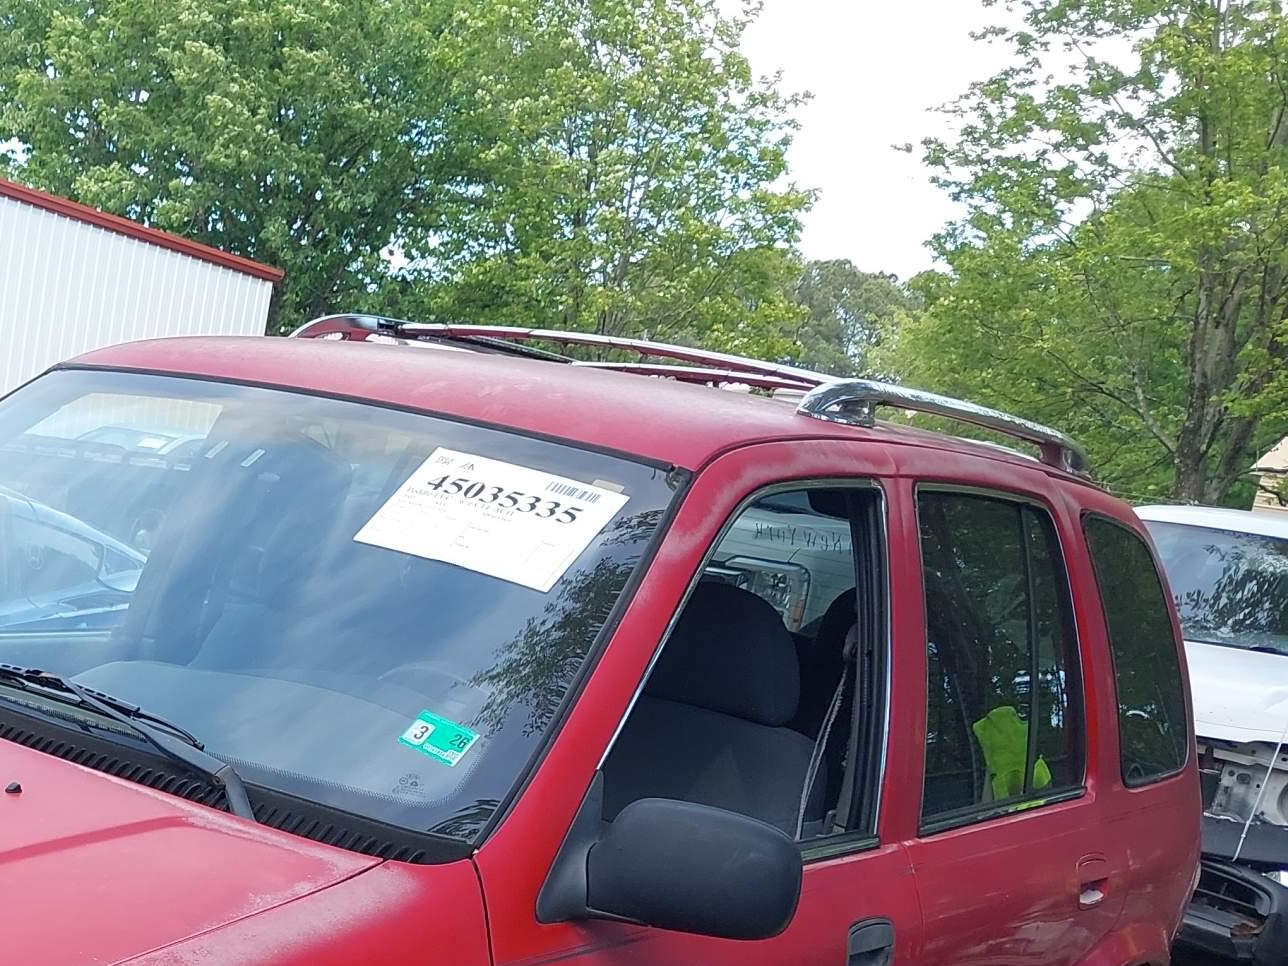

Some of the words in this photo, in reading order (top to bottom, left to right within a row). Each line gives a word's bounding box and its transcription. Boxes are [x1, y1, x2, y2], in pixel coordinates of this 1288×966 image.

[427, 474, 585, 524] 45035335
[414, 725, 429, 740] 3
[448, 733, 470, 749] 26
